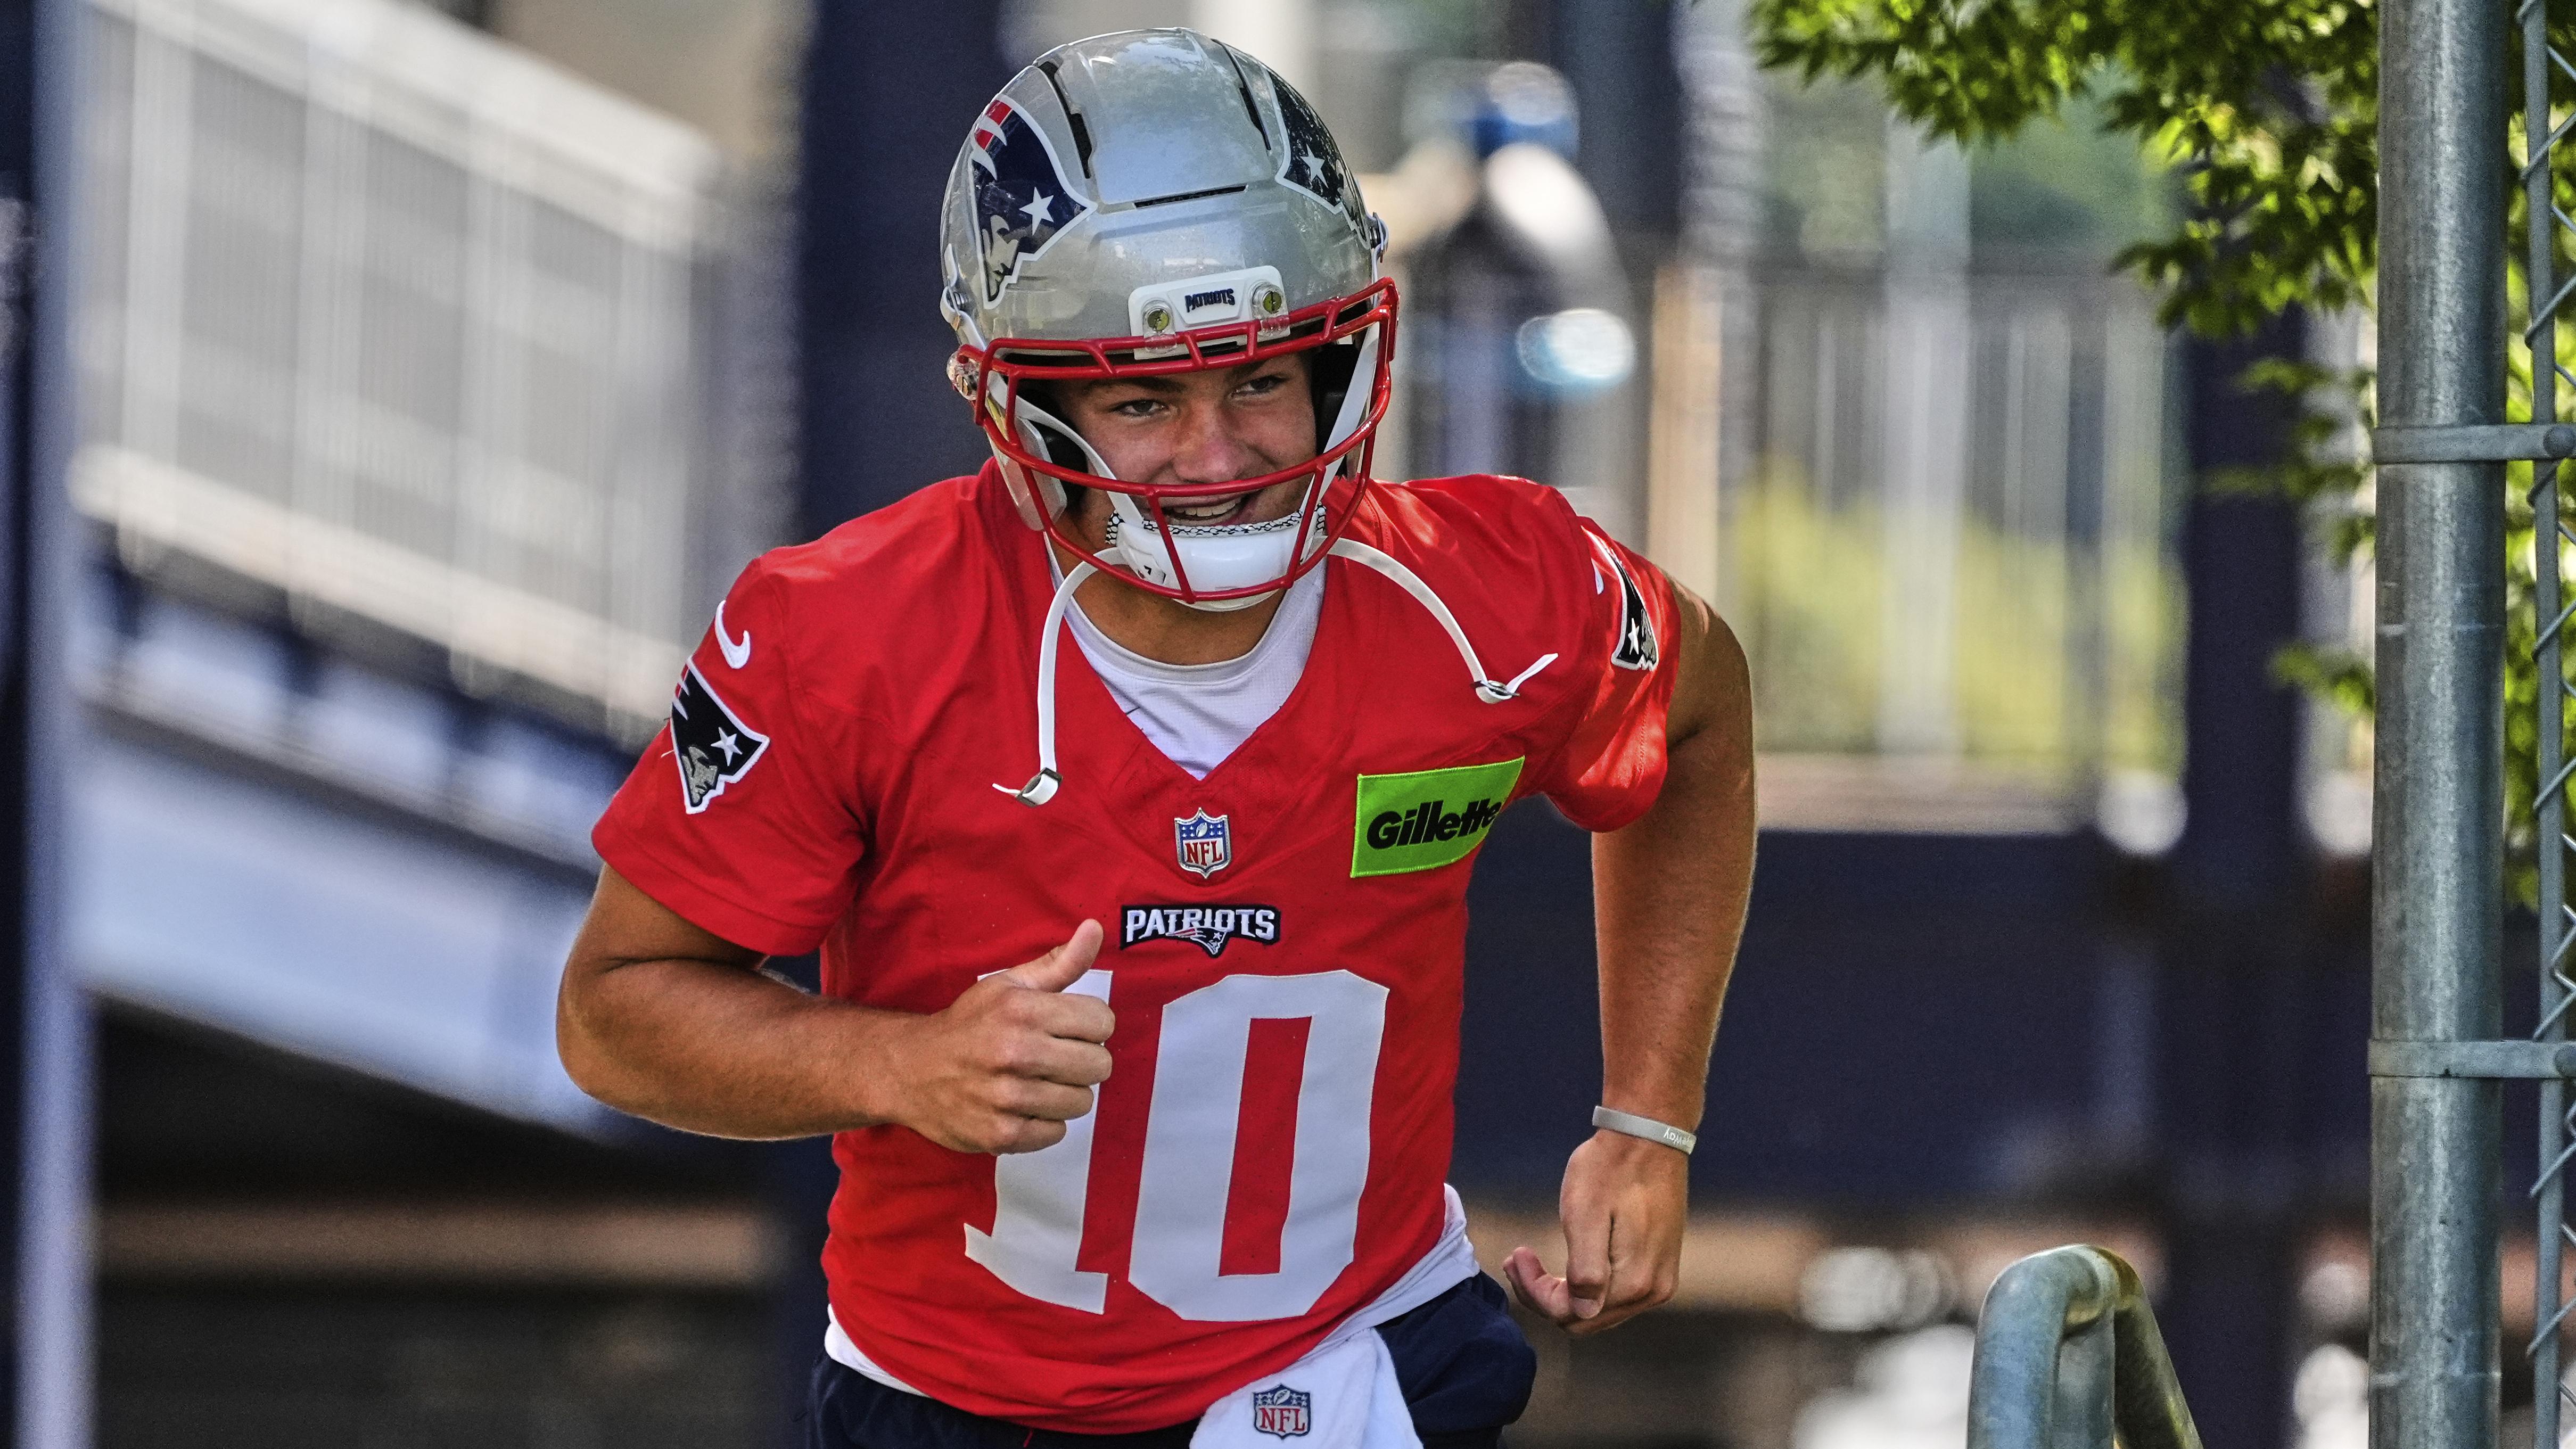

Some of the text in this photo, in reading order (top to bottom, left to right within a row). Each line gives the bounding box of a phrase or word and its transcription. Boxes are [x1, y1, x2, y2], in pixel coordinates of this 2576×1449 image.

[1185, 288, 1236, 313] PATRIOTS
[1366, 798, 1502, 850] Gillette
[1184, 841, 1223, 867] NFL
[1126, 909, 1275, 943] PATRIOTS
[964, 969, 1390, 1322] 10
[1258, 1407, 1306, 1433] NFL
